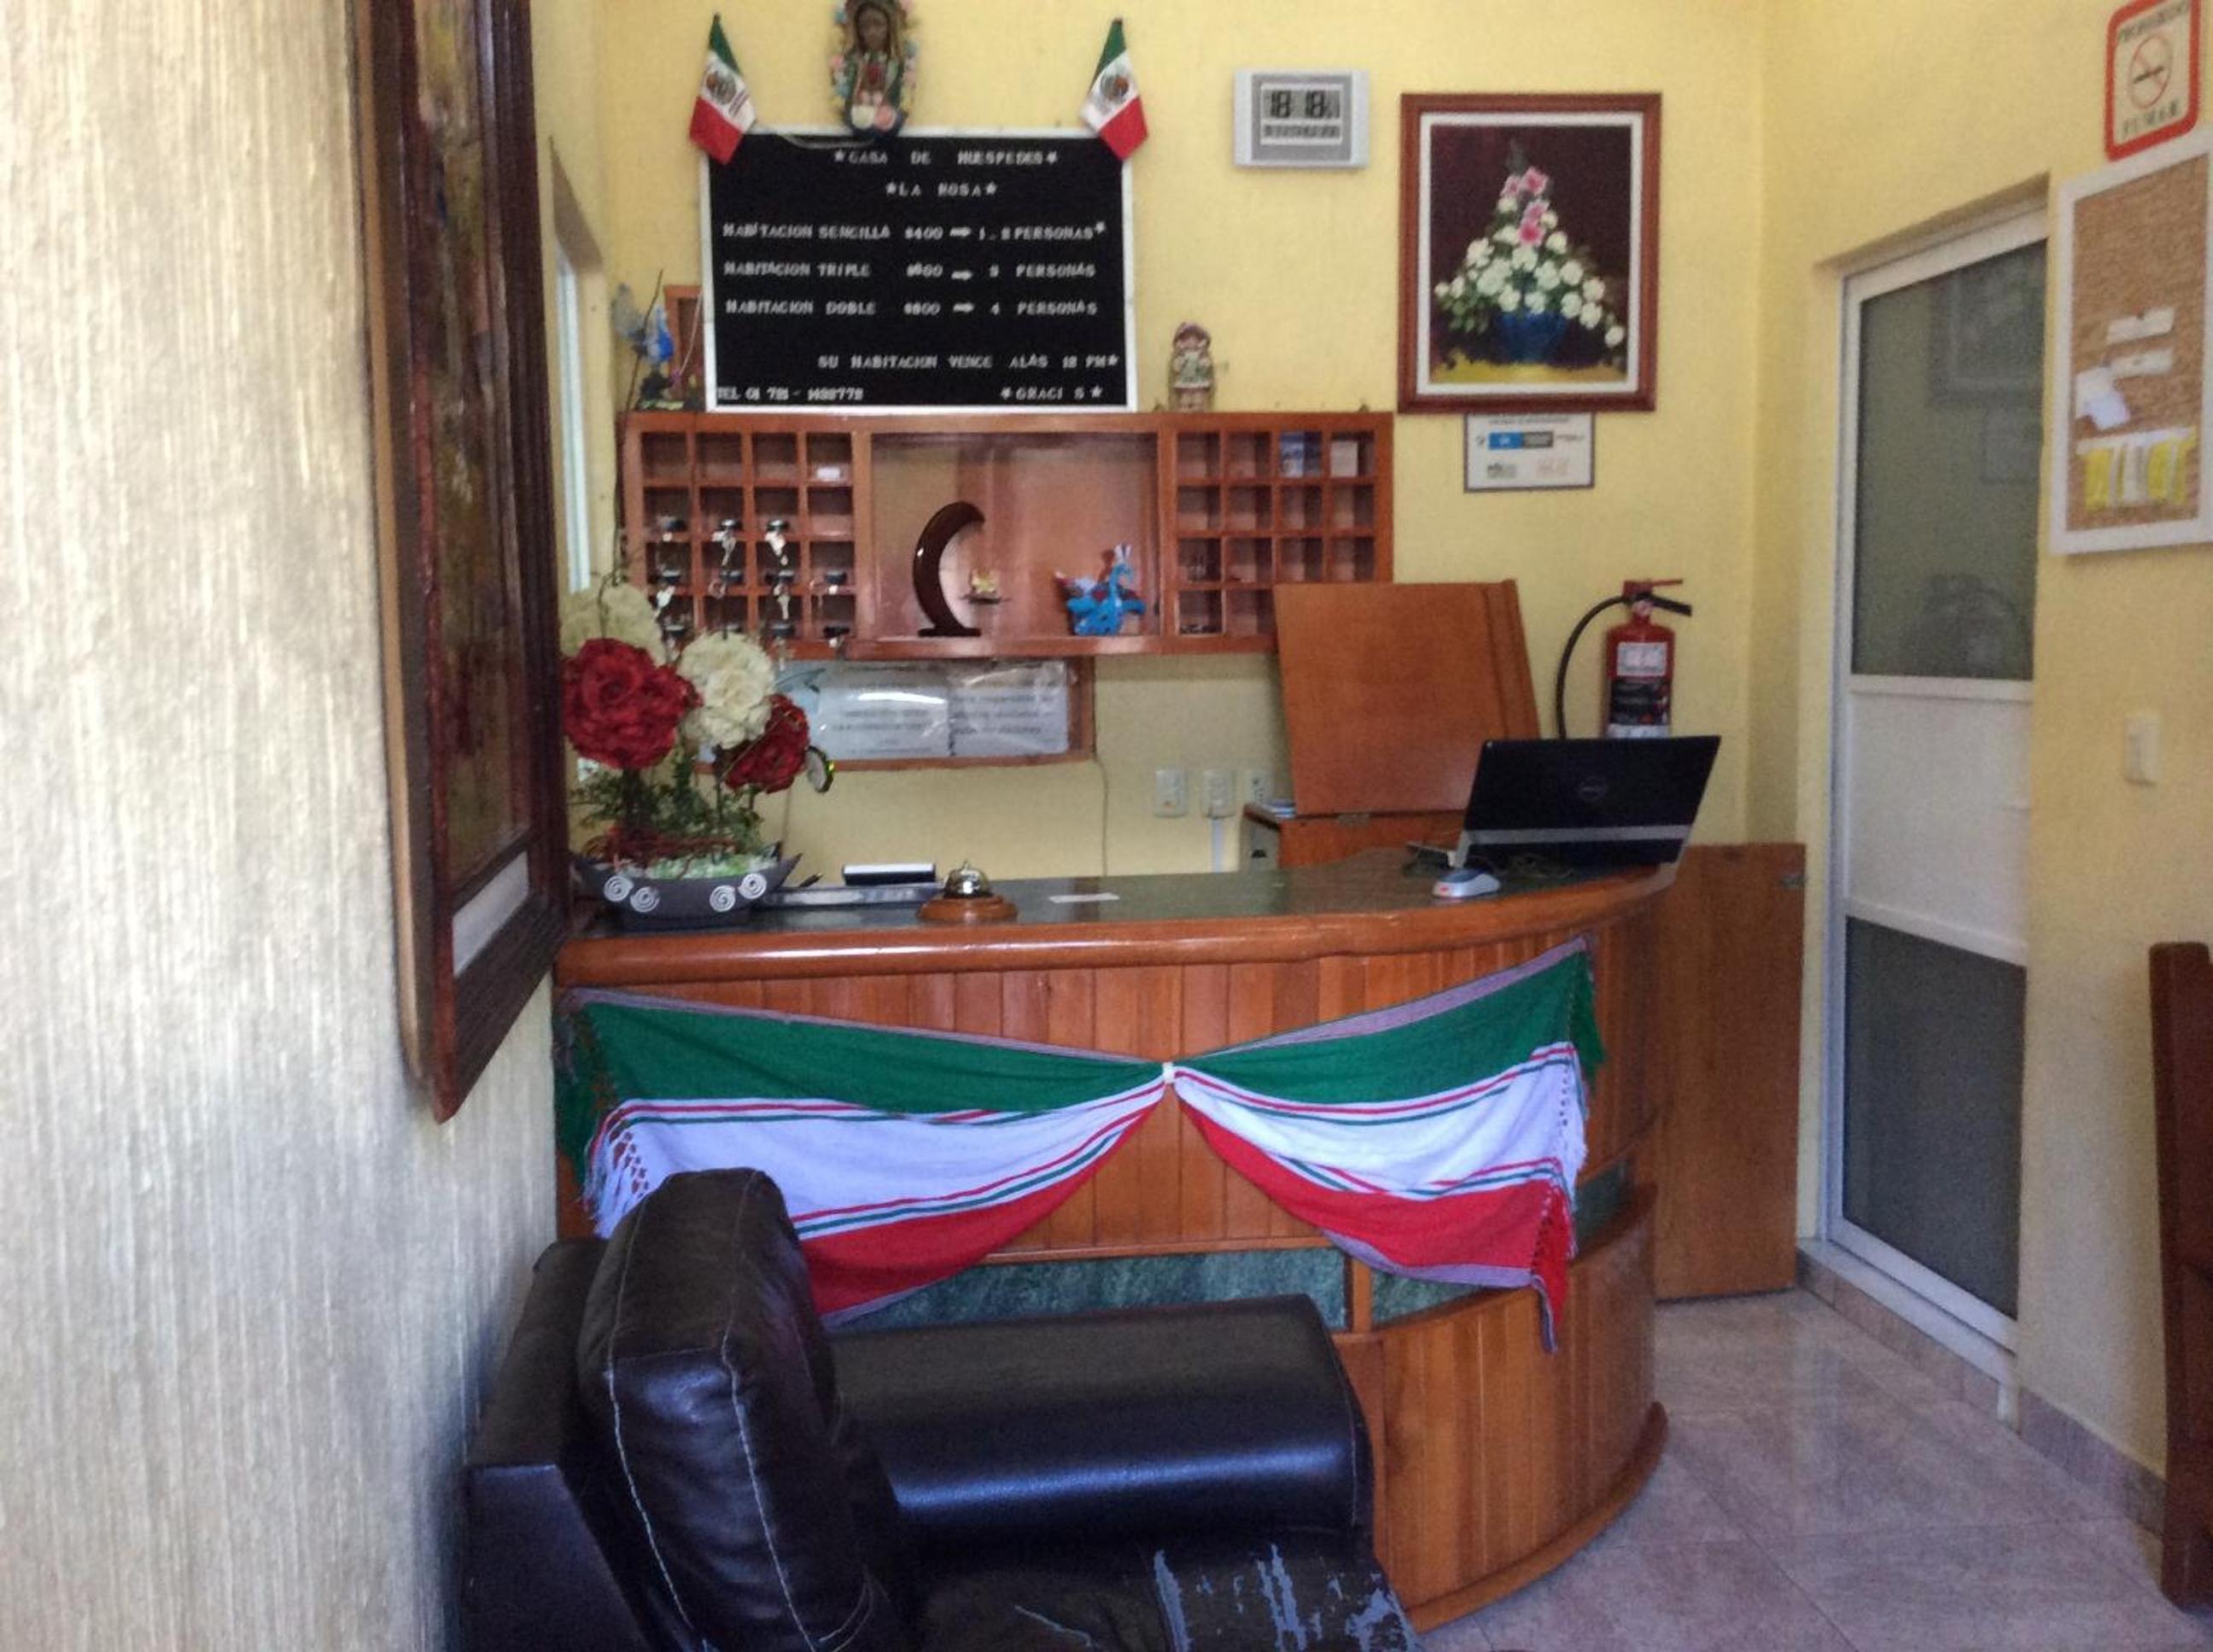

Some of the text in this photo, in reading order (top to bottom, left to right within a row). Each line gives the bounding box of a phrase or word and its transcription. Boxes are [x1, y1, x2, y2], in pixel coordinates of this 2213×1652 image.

[910, 150, 931, 165] DE
[898, 182, 921, 196] LA
[1015, 262, 1096, 278] PERSONAS
[826, 301, 875, 315] DOBLE
[1017, 300, 1098, 316] PERSONAS
